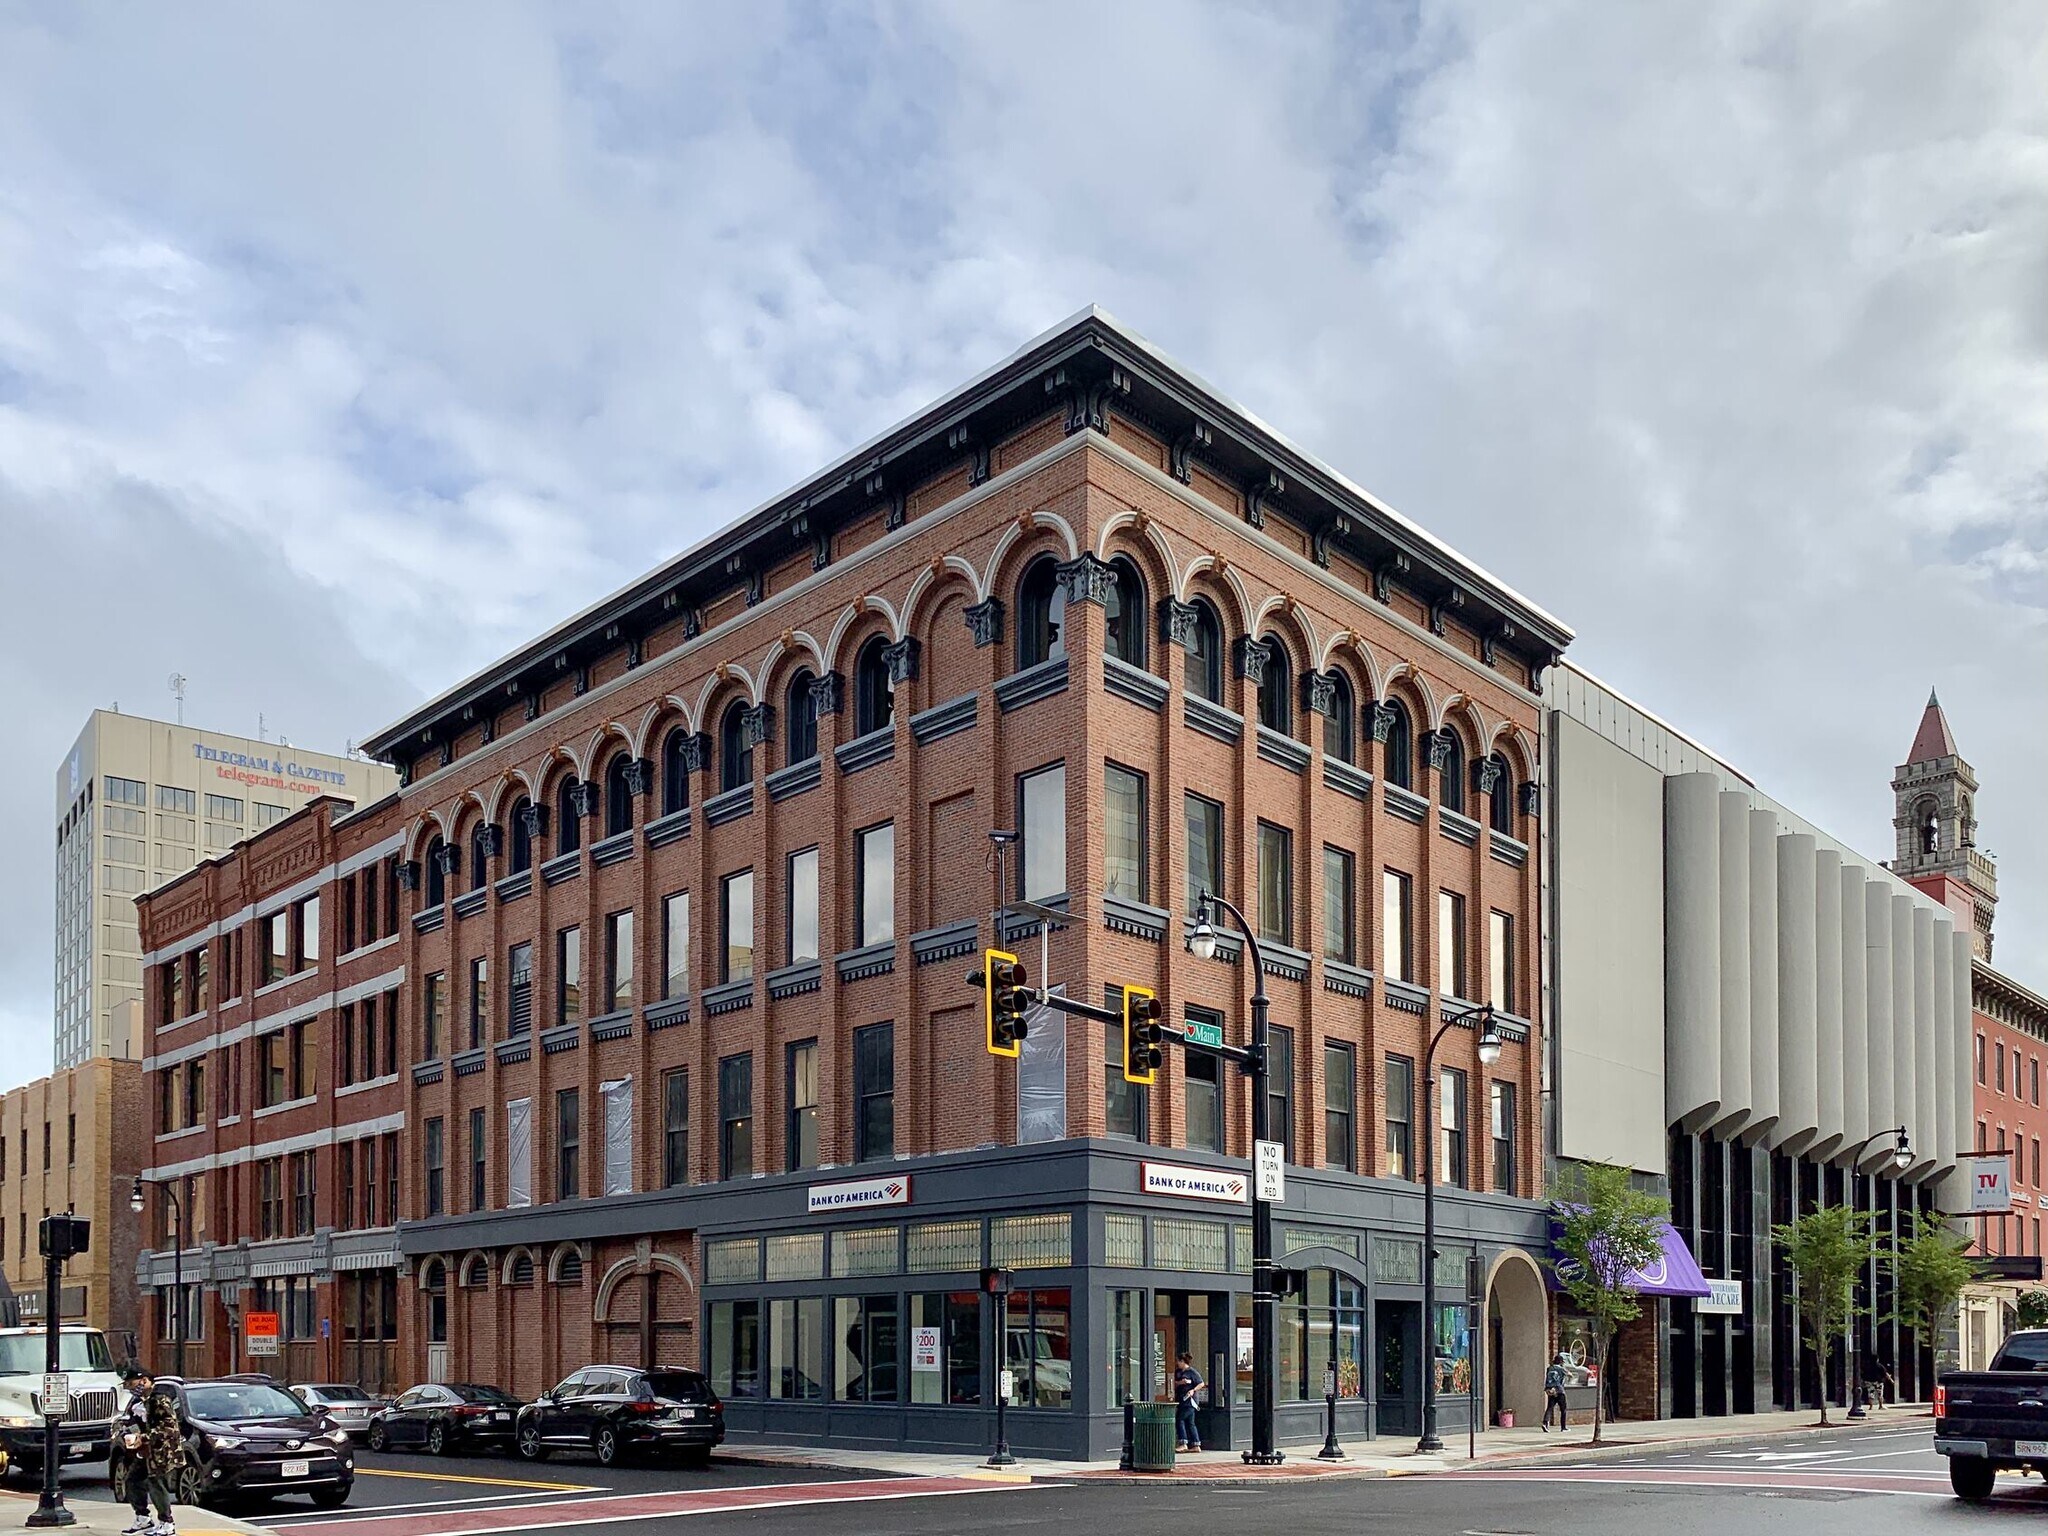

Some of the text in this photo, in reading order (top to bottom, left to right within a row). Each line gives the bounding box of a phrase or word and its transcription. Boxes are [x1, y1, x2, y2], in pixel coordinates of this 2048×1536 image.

[272, 757, 284, 775] &
[216, 765, 321, 795] telegram.com
[1194, 1024, 1216, 1044] Main
[1263, 1146, 1277, 1158] NO
[1262, 1160, 1279, 1171] TURN
[1149, 1176, 1226, 1194] BANK OF AMERICA
[1265, 1173, 1276, 1184] ON
[1978, 1174, 1998, 1188] TV
[811, 1190, 884, 1206] BANK OF AMERICA
[1264, 1186, 1277, 1197] RED
[915, 1335, 935, 1347] $200
[2032, 1445, 2047, 1455] 992
